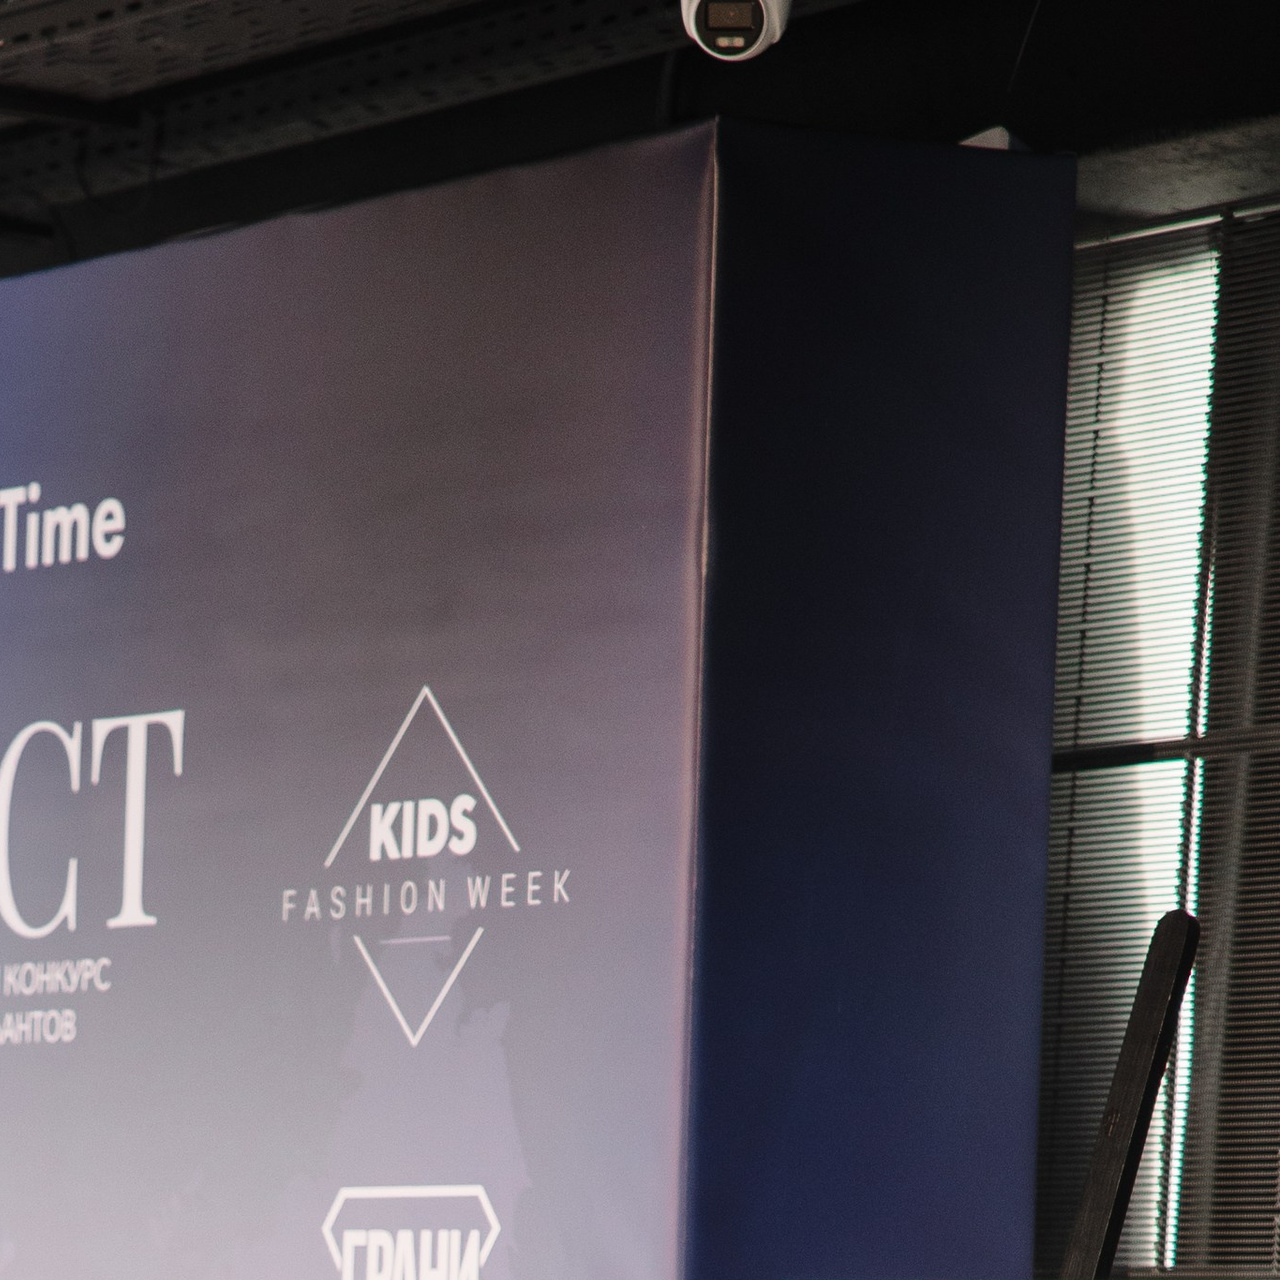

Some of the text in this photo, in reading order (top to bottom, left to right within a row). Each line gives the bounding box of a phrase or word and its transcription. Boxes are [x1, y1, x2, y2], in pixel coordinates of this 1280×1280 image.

[370, 793, 478, 862] KIDS
[281, 868, 570, 922] FASHION WEEK
[3, 957, 112, 998] КОНКУРС
